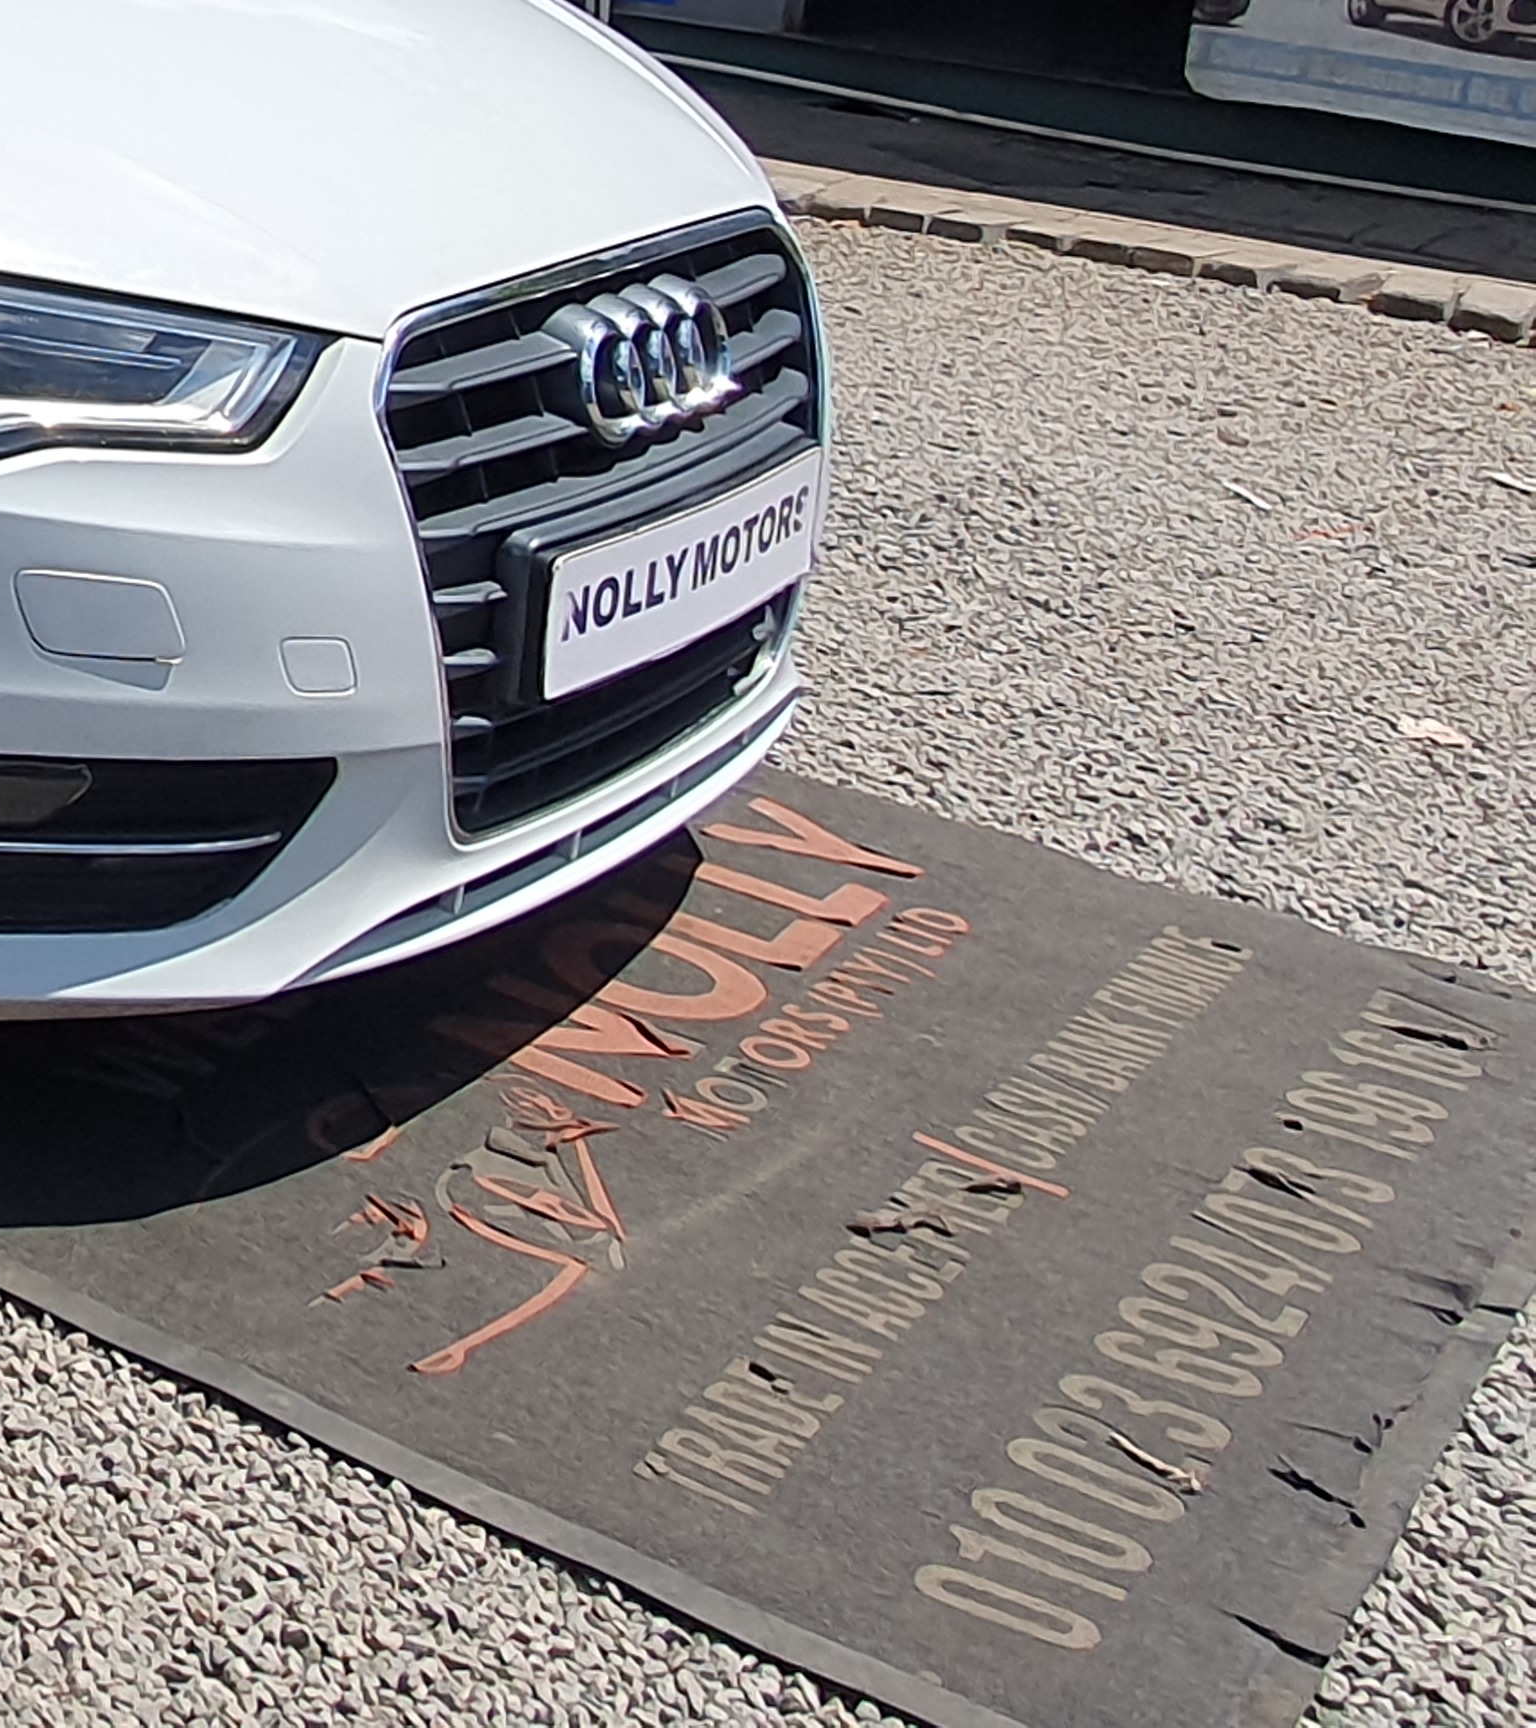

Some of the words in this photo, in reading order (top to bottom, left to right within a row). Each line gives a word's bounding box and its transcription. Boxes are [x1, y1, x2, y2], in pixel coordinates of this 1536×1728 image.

[561, 547, 689, 643] NOLLY
[691, 484, 810, 591] MOTORS
[448, 796, 926, 1109] NOLLY
[1274, 1070, 1450, 1162] 196
[632, 1356, 846, 1517] TRADE
[753, 1312, 884, 1385] IN
[1092, 925, 1254, 1029] FINANCE
[1006, 1373, 1233, 1522] 023
[914, 1486, 1155, 1652] 010
